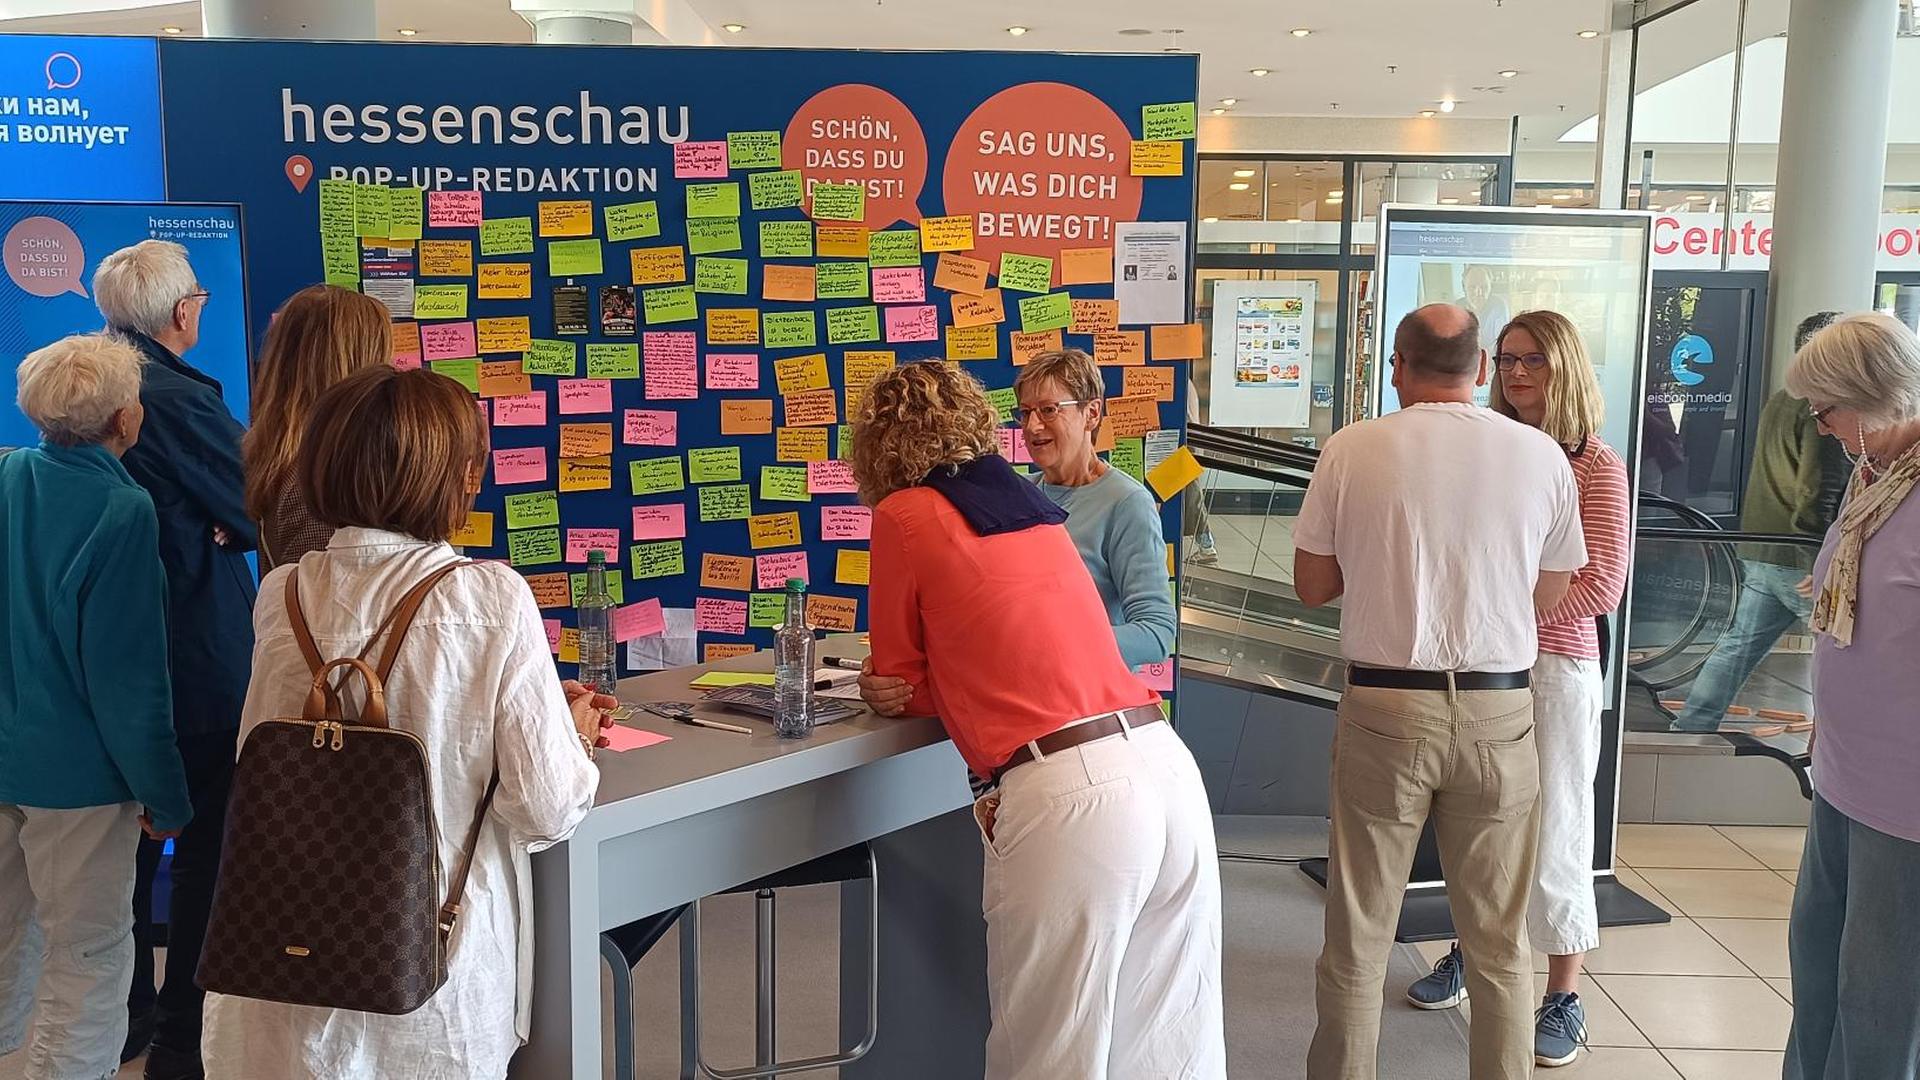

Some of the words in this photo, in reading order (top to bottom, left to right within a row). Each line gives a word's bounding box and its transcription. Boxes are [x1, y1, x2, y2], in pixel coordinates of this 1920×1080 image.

[28, 97, 89, 120] нам,
[282, 88, 689, 145] hessenschau
[18, 124, 129, 149] волнует
[810, 115, 898, 143] SCHÖN,
[978, 130, 1036, 156] SAG
[1046, 132, 1115, 162] UNS,
[806, 149, 865, 169] DASS
[873, 150, 905, 170] DU
[330, 166, 658, 192] POP-UP-REDAKTION
[973, 170, 1039, 198] WAS
[1047, 173, 1117, 199] DICH
[149, 216, 235, 230] hessenschau
[978, 212, 1111, 241] BEWEGT!
[1653, 217, 1771, 256] Cente
[20, 253, 49, 262] DASS
[52, 254, 67, 263] DU
[22, 267, 36, 277] DA
[40, 267, 69, 277] BIST!
[1647, 391, 1732, 404] eisbach.media
